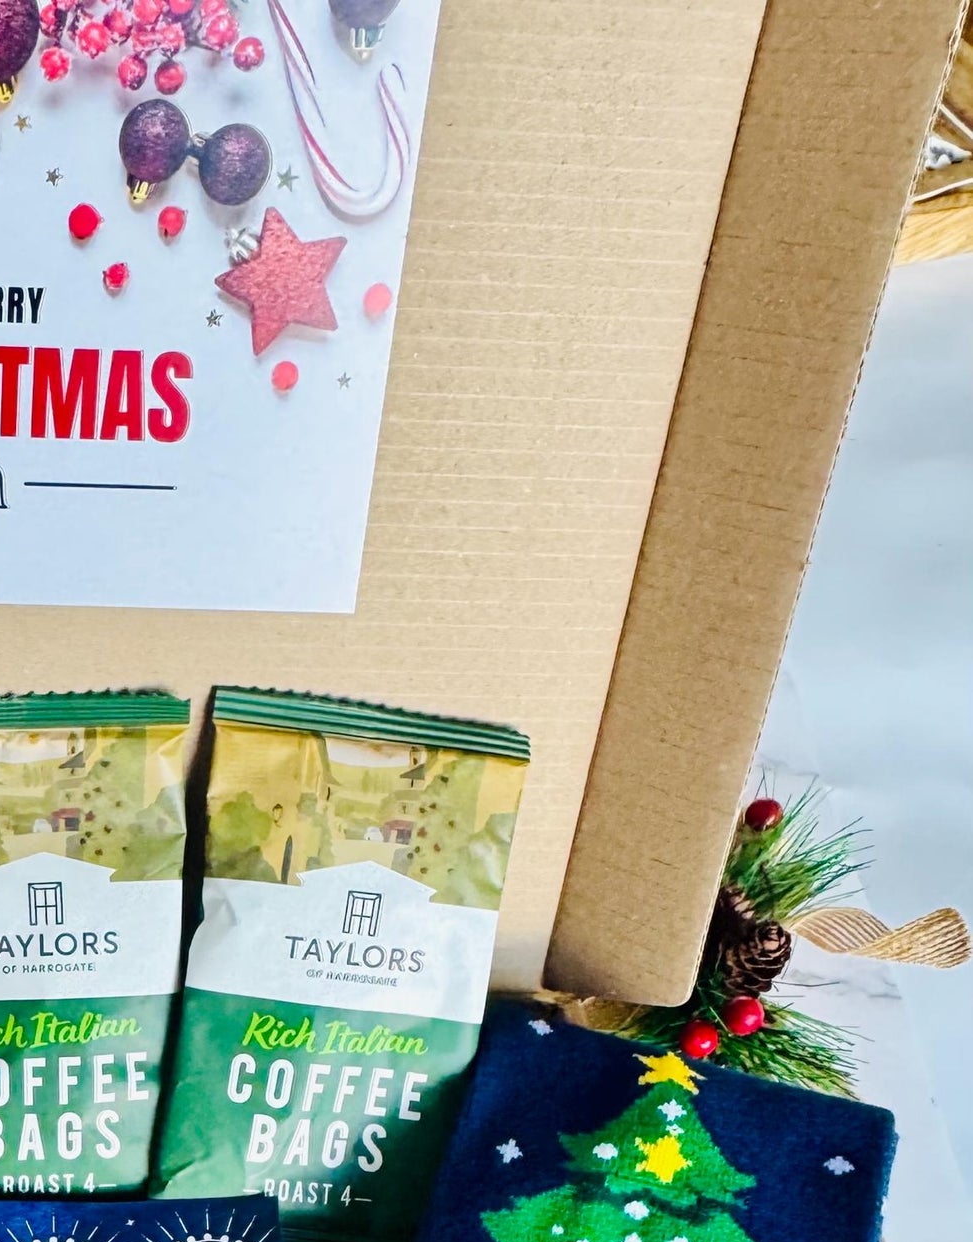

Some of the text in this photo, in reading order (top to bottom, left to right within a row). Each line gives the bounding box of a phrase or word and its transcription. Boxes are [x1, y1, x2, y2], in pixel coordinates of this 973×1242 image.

[2, 962, 95, 974] OF HARROGATE
[284, 935, 427, 974] TAYLORS
[29, 1011, 141, 1050] Italian
[242, 1011, 428, 1056] Rich Italian
[227, 1053, 429, 1122] COFFEE
[246, 1113, 388, 1173] BAGS
[2, 1172, 96, 1194] ROAST 4
[264, 1177, 352, 1208] ROAST 4
